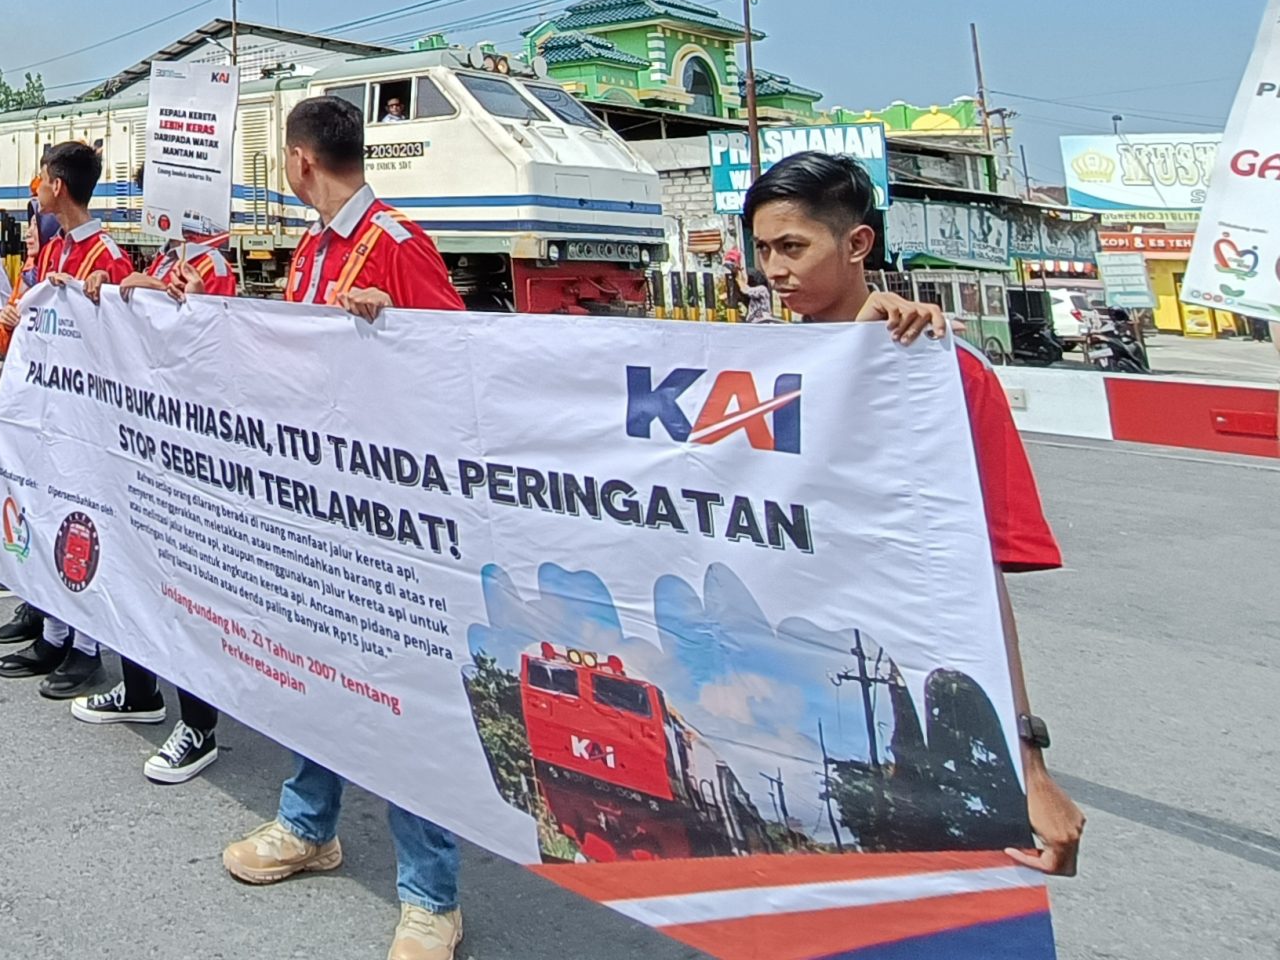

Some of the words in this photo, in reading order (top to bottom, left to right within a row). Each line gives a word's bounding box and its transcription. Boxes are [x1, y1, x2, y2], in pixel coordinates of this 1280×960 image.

[154, 132, 191, 145] DARIPADA
[193, 137, 218, 149] WATAK
[159, 120, 183, 131] LEBIH
[186, 123, 215, 135] KERAS
[160, 108, 186, 118] KEPALA
[189, 111, 216, 121] KERETA
[163, 147, 195, 159] MANTAN
[196, 151, 208, 160] MU
[371, 143, 422, 157] 2030203
[626, 365, 803, 455] KAI
[26, 361, 84, 395] PALANG
[87, 373, 123, 408] PINTU
[124, 385, 181, 428] BUKAN
[185, 402, 273, 456] HIASAN,
[277, 424, 321, 465] ITU
[327, 434, 452, 495] TANDA
[458, 458, 815, 554] PERINGATAN
[119, 424, 156, 463] STOP
[161, 440, 255, 499] SEBELUM
[259, 470, 461, 560] TERLAMBAT!
[48, 485, 100, 510] Dipersembahkan
[193, 494, 221, 517] dilarang
[221, 506, 249, 525] berada
[250, 516, 259, 527] di
[261, 523, 286, 541] ruang
[288, 528, 328, 552] manfaat
[329, 541, 352, 561] jalur
[356, 551, 393, 574] kereta
[397, 565, 420, 583] api,
[251, 536, 271, 551] atau
[273, 543, 345, 578] memindahkan
[344, 569, 382, 595] barang
[385, 583, 396, 596] di
[399, 590, 425, 606] atas
[429, 597, 447, 612] rel
[179, 541, 198, 557] selain
[199, 551, 220, 567] untuk
[222, 560, 259, 586] angkutan
[260, 575, 289, 598] kereta
[291, 592, 307, 608] api.
[310, 596, 358, 626] Ancaman
[361, 617, 400, 642] pidana
[404, 633, 453, 660] penjara
[184, 526, 206, 543] kereta
[222, 543, 255, 564] ataupun
[257, 557, 320, 589] menggunakan
[322, 578, 345, 598] jalur
[348, 590, 385, 613] kereta
[388, 605, 407, 622] api
[410, 614, 450, 636] untuk
[199, 566, 219, 585] bulan
[220, 580, 238, 595] atau
[239, 586, 264, 607] denda
[266, 599, 293, 623] paling
[294, 612, 330, 636] banyak
[332, 625, 359, 647] Rp15
[161, 582, 230, 635] Undang-undang
[231, 619, 250, 642] No.
[266, 637, 304, 668] Tahun
[306, 656, 337, 683] 2007
[340, 672, 402, 716] tentang
[221, 638, 306, 695] Perkeretaapian
